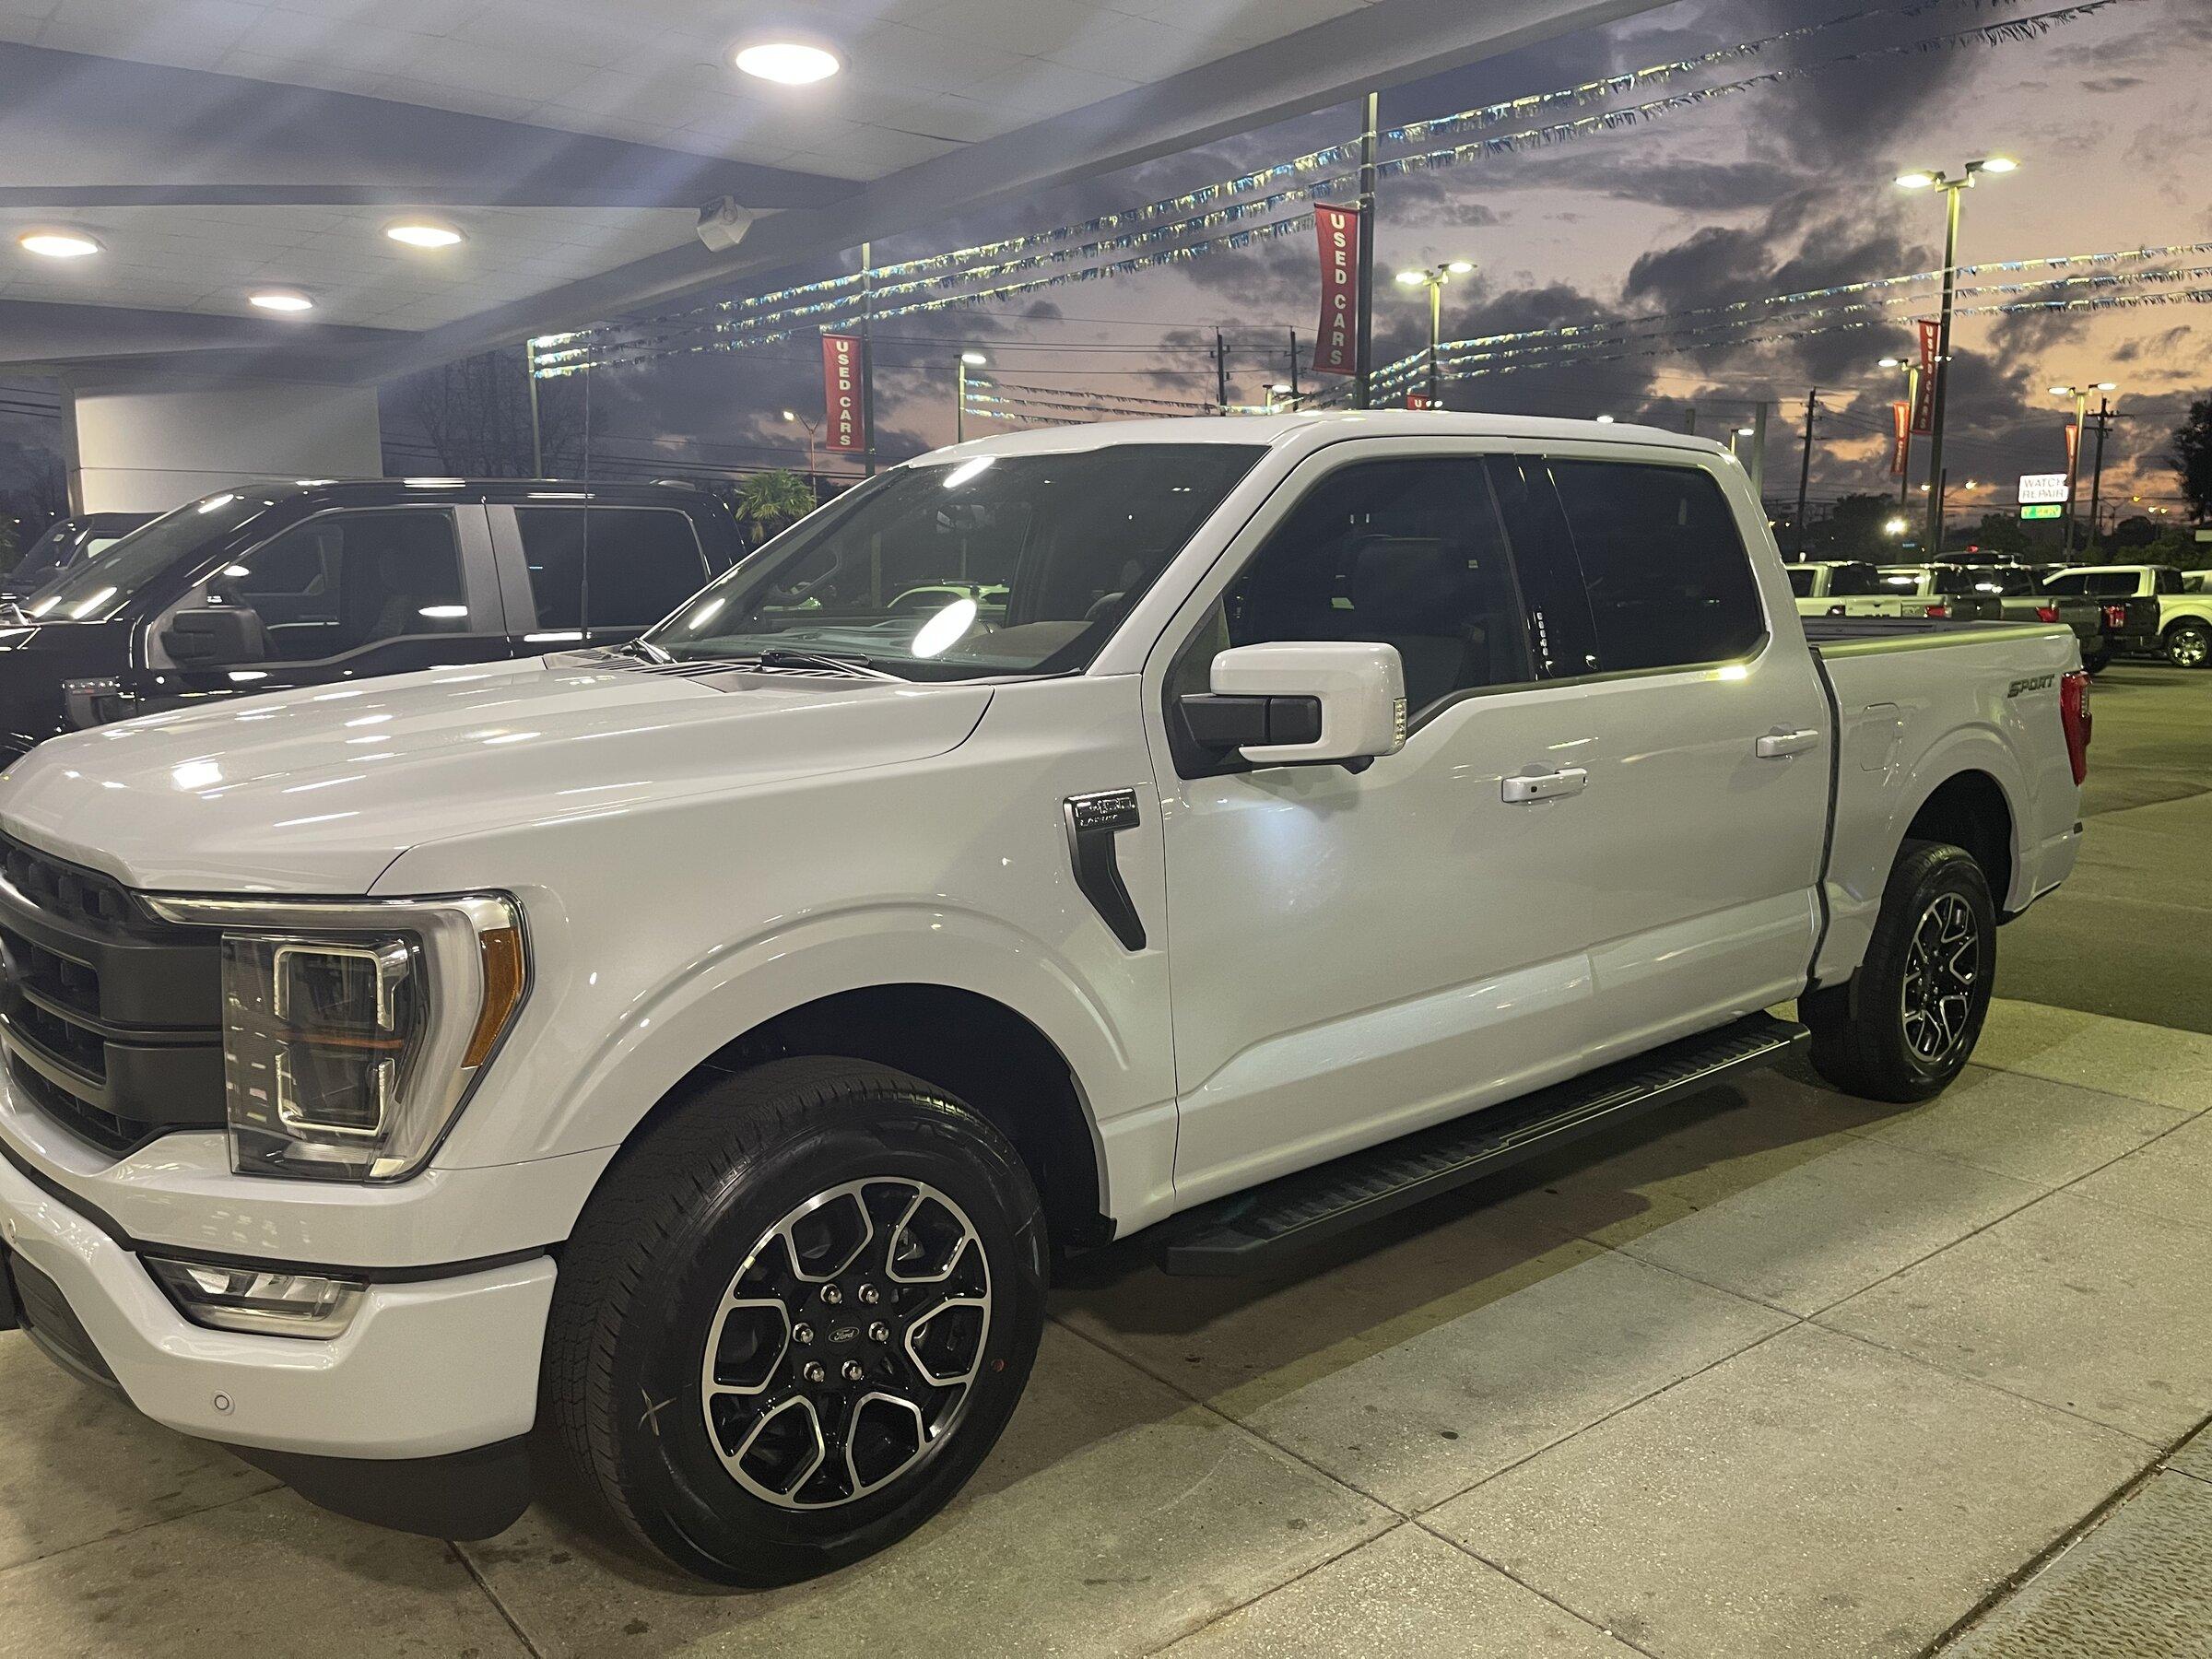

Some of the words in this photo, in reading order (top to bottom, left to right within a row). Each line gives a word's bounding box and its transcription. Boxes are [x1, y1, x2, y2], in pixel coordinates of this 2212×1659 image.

[1330, 213, 1347, 285] USED
[1330, 294, 1347, 365] CARS
[836, 341, 851, 391] USED
[840, 396, 852, 446] CARS
[2007, 674, 2054, 699] SPORT
